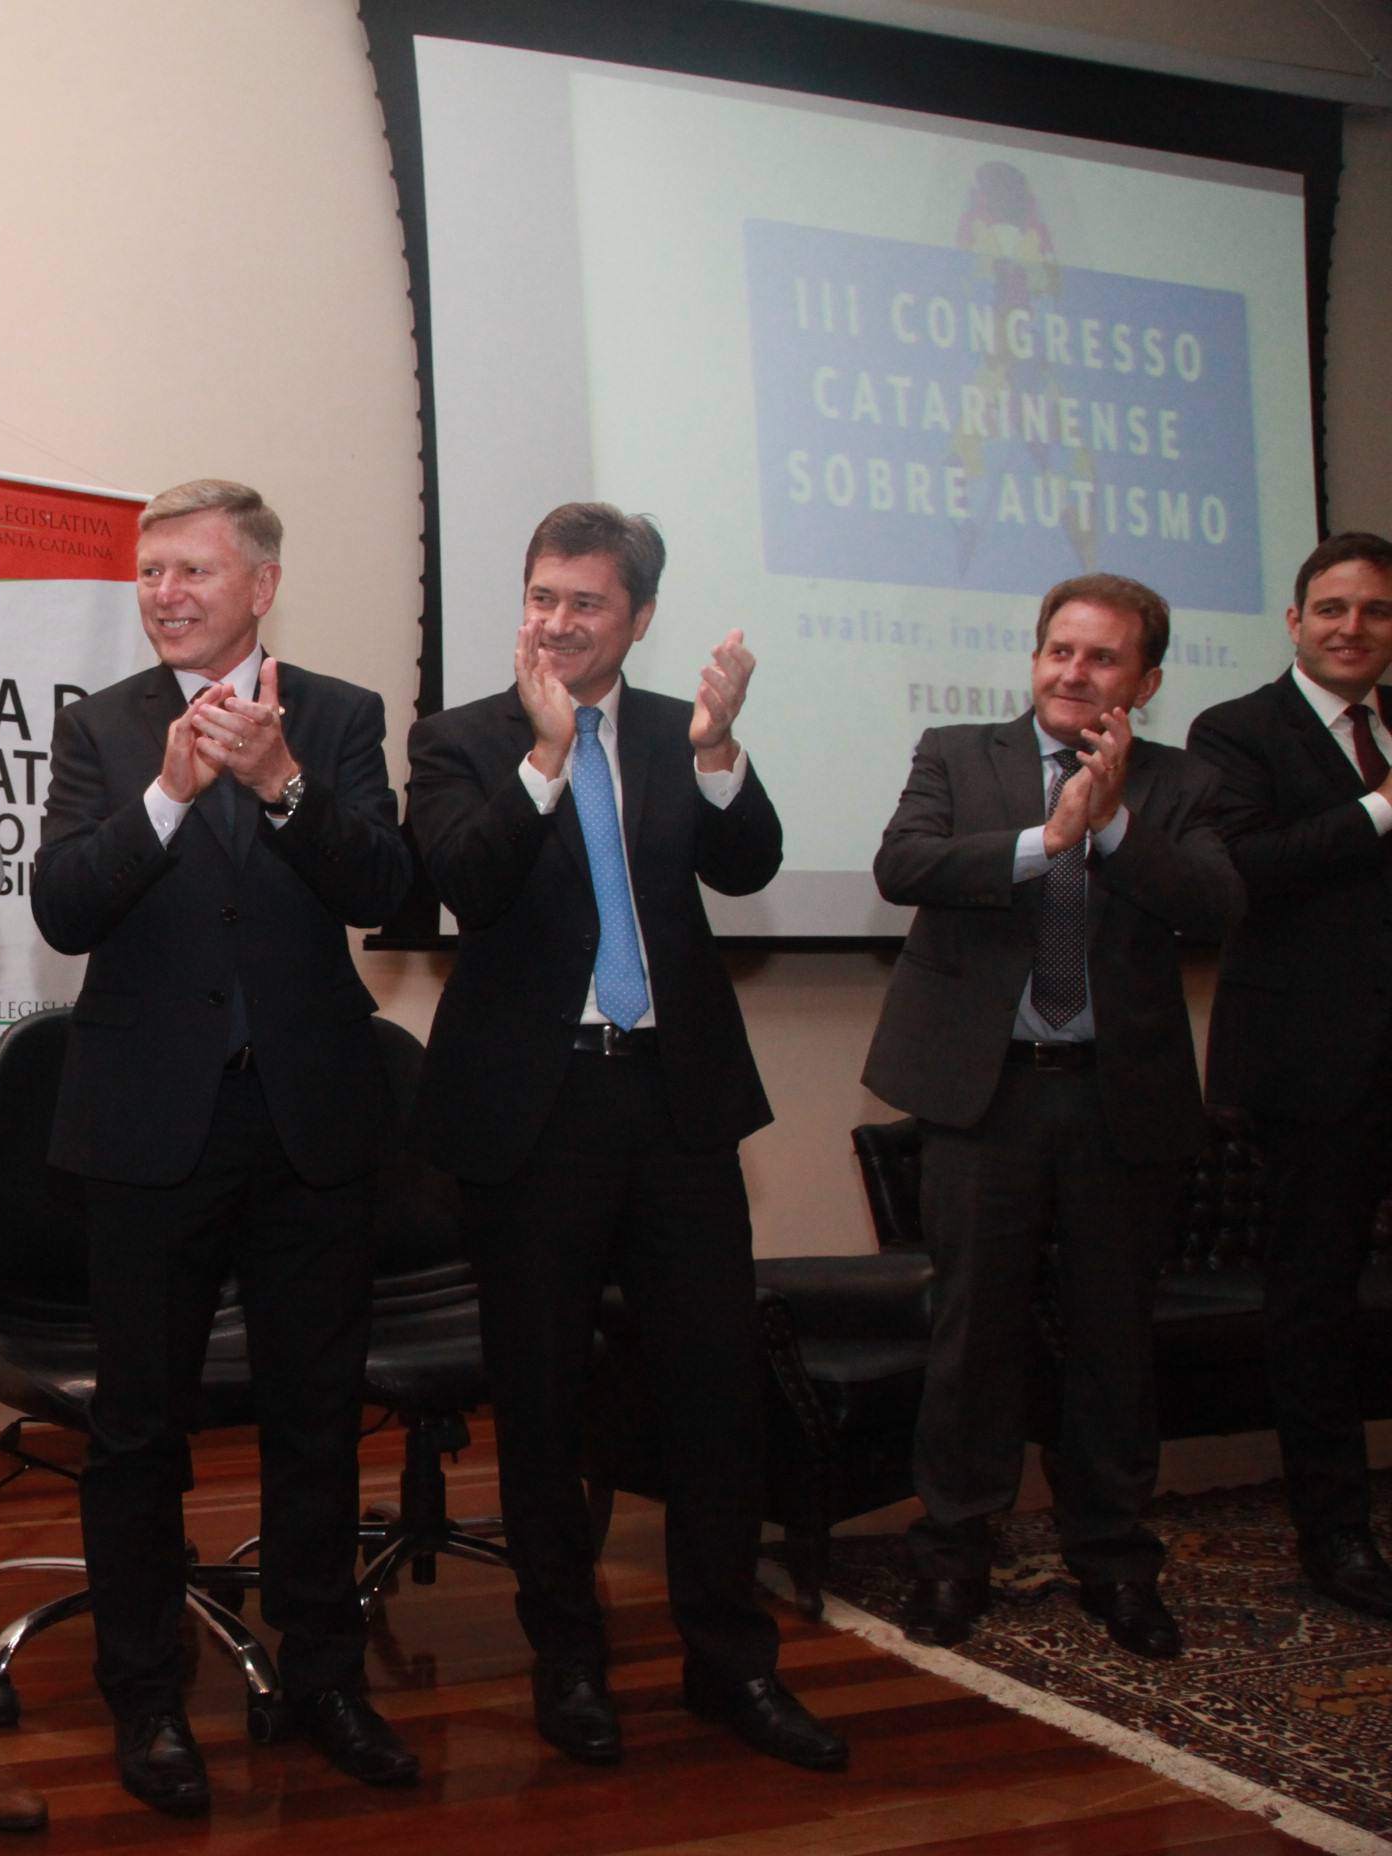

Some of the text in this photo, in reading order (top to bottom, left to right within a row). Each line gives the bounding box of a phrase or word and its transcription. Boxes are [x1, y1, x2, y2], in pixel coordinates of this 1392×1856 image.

[795, 278, 1202, 382] III CONGRESSO
[812, 366, 1181, 460] CATARINENSE
[787, 450, 1227, 545] SOBRE AUTISMO
[39, 537, 114, 561] CATARINA
